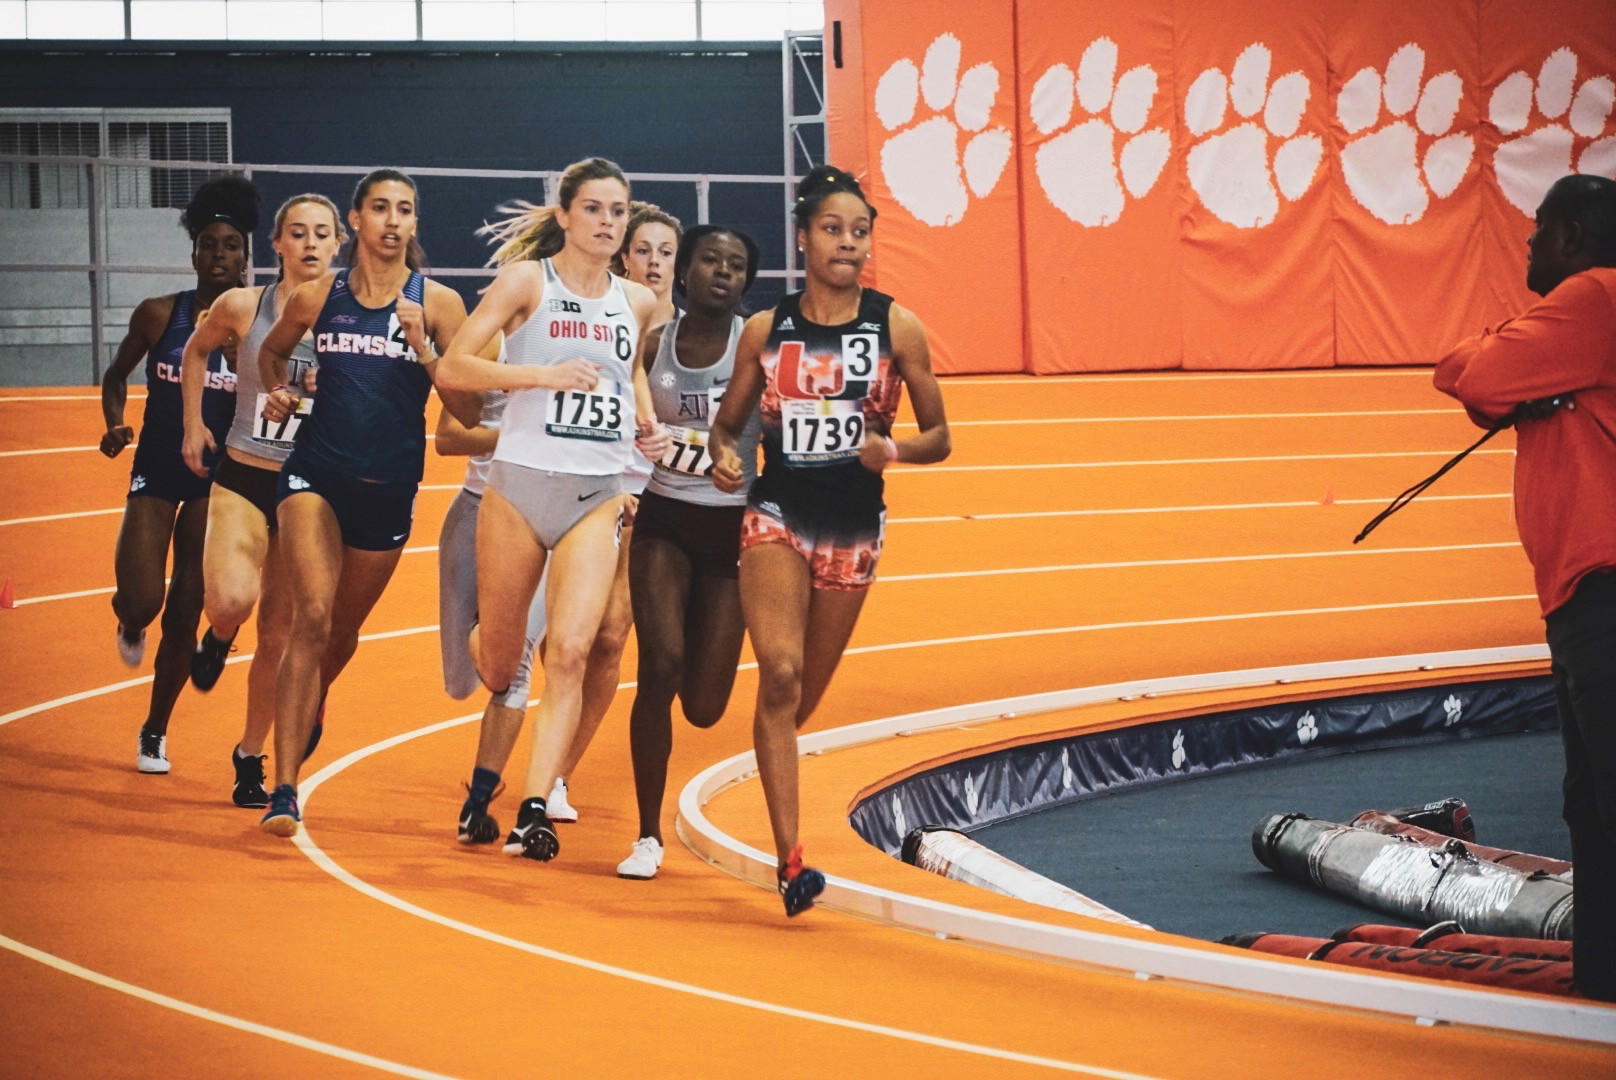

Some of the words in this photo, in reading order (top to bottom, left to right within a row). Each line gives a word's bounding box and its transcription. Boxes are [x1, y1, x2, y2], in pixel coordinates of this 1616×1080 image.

[550, 320, 588, 339] OHIO
[615, 324, 632, 361] 6
[857, 322, 881, 331] ACC
[848, 337, 872, 377] 3
[554, 391, 621, 430] 1753
[789, 415, 862, 452] 1739
